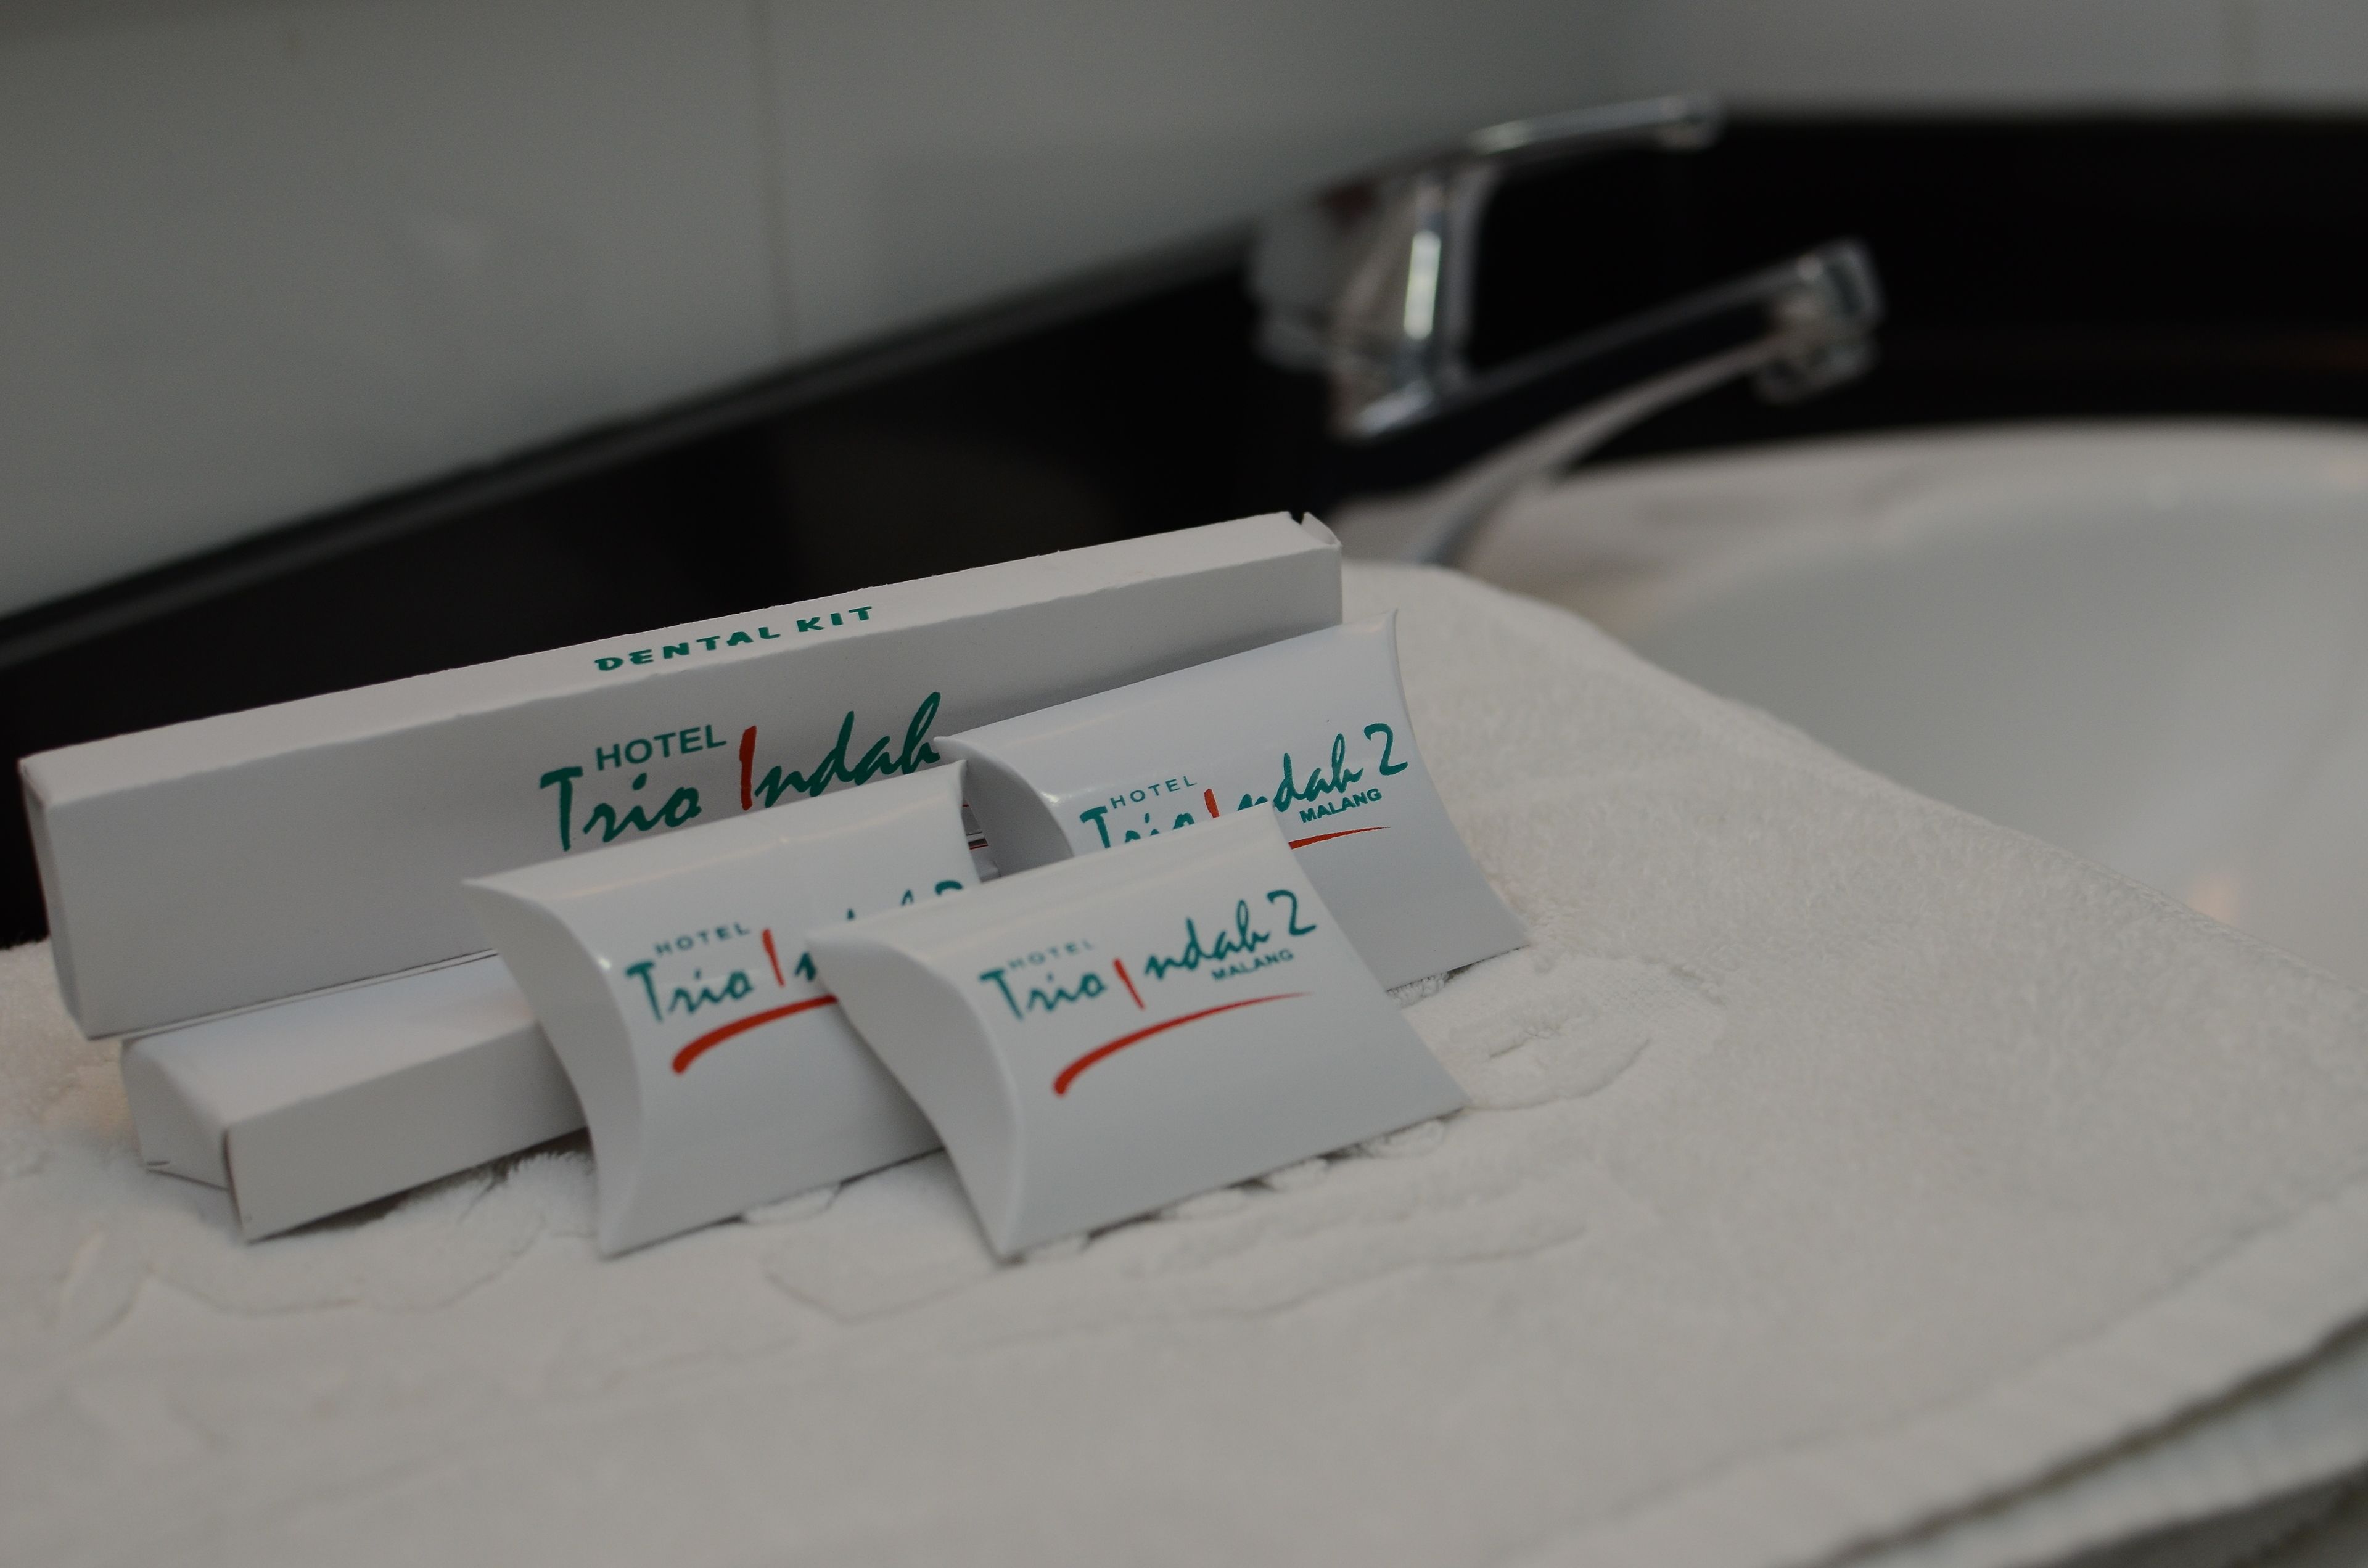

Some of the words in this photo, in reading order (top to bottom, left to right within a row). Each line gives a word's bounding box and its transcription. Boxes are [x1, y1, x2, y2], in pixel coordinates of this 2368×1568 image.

[595, 625, 781, 671] DENTAL
[796, 605, 873, 633] KIT
[596, 724, 726, 771] HOTEL
[1363, 722, 1409, 777] 2
[539, 766, 702, 851] Trio
[740, 692, 941, 810] Indah
[1109, 774, 1197, 810] HOTEL
[1299, 787, 1383, 824] MALANG
[654, 922, 750, 958] HOTEL
[978, 967, 1108, 1022] Trio
[1112, 899, 1270, 1011] Indah
[1265, 888, 1317, 937] 2
[1007, 937, 1093, 972] HOTEL
[1211, 949, 1294, 982] MALANG
[626, 960, 754, 1023] Trio
